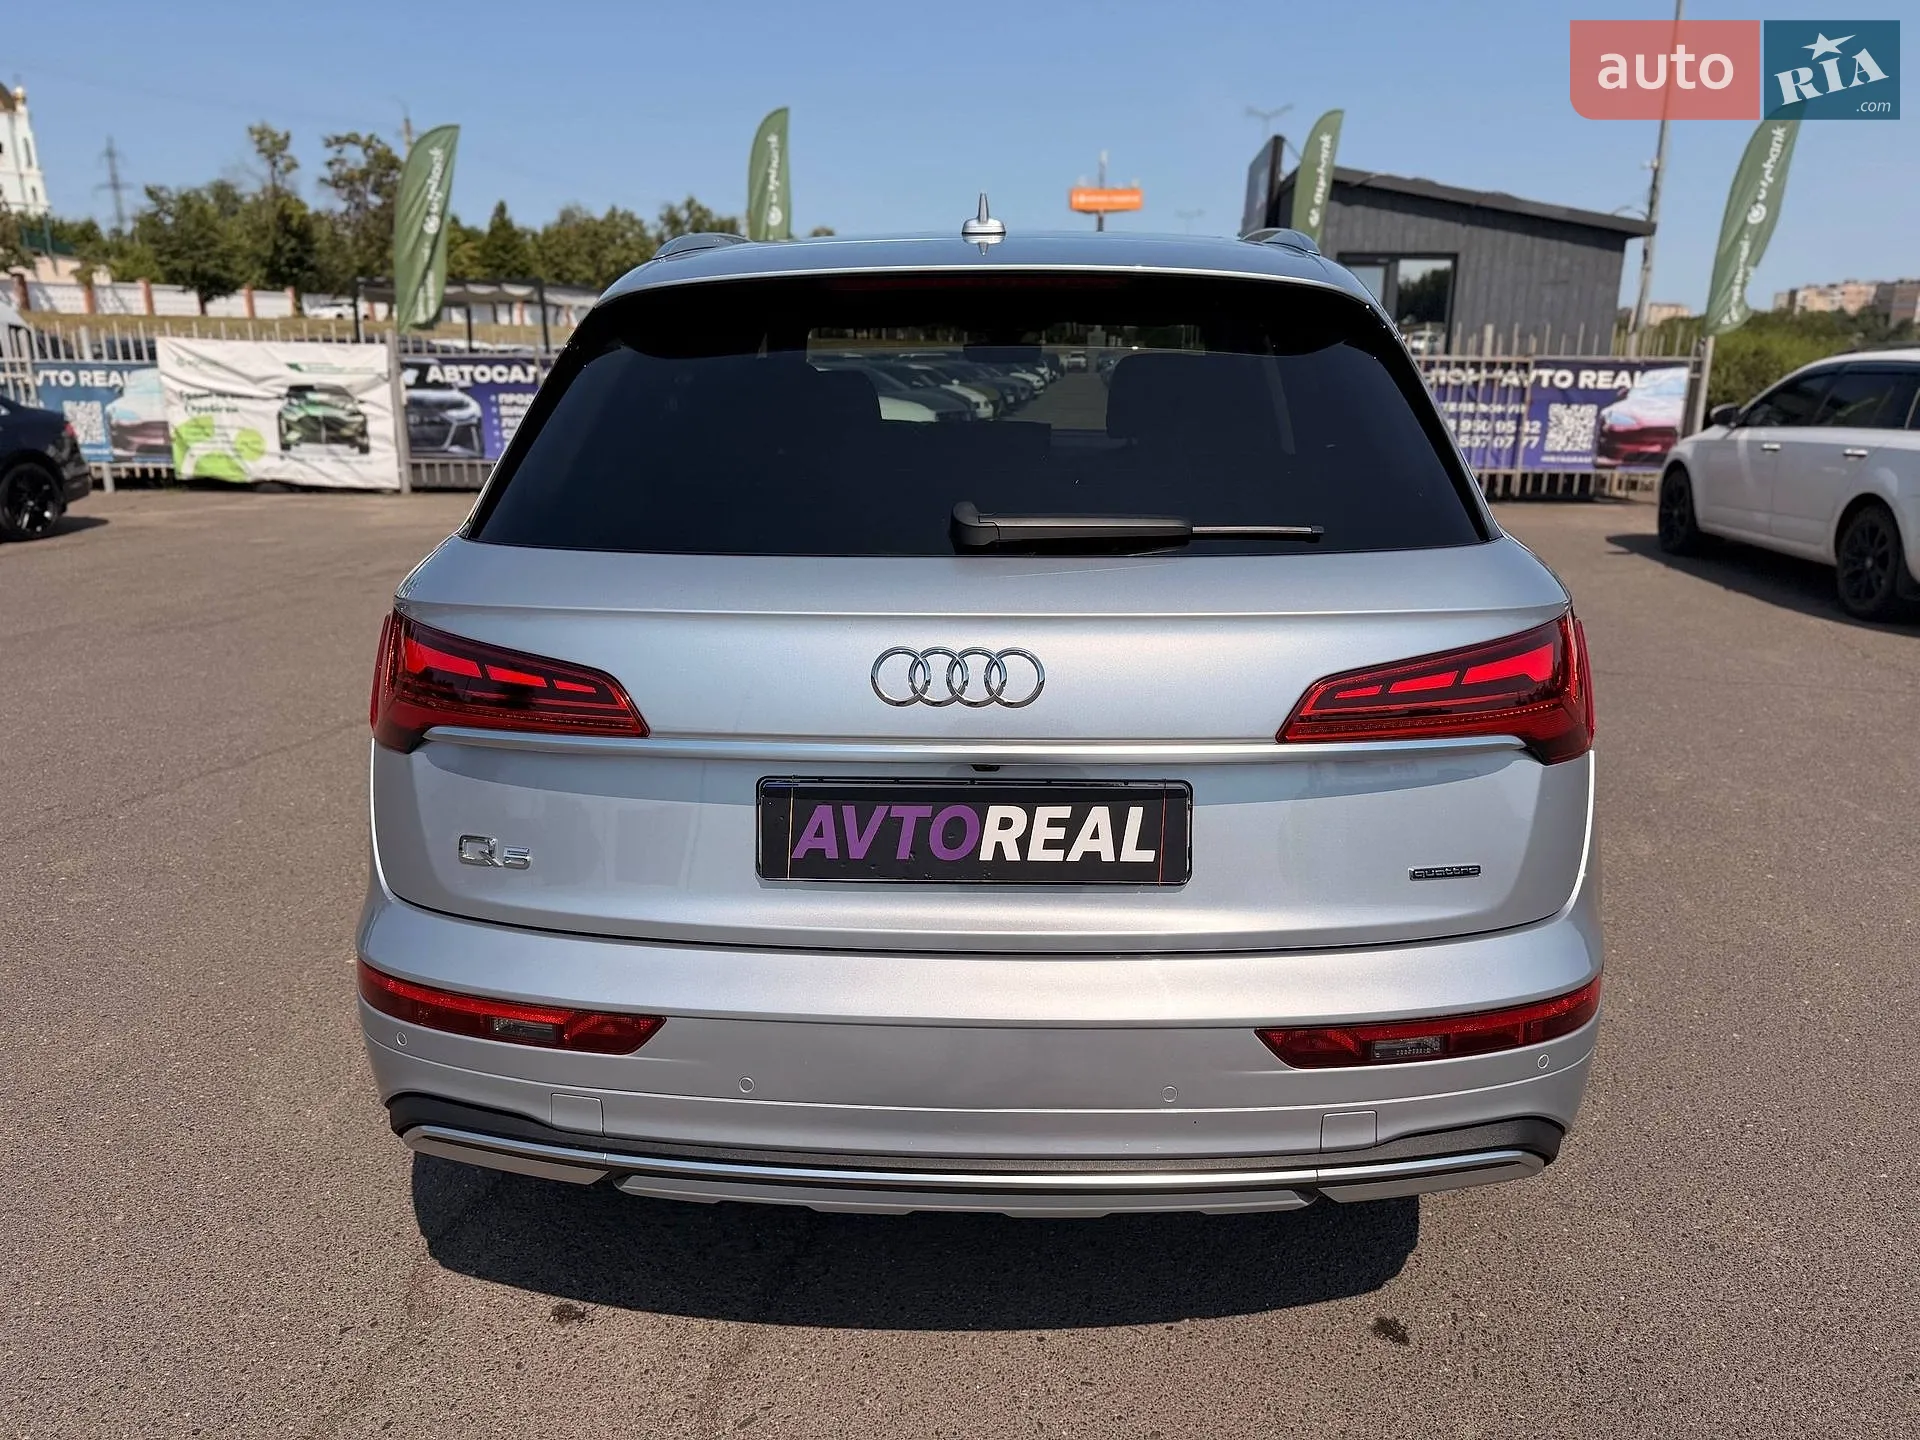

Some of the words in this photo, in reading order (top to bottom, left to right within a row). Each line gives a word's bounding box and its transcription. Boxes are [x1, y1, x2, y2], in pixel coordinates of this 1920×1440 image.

[791, 804, 1157, 863] AVTOREAL
[458, 834, 532, 870] Q5
[1413, 866, 1480, 879] quattro
